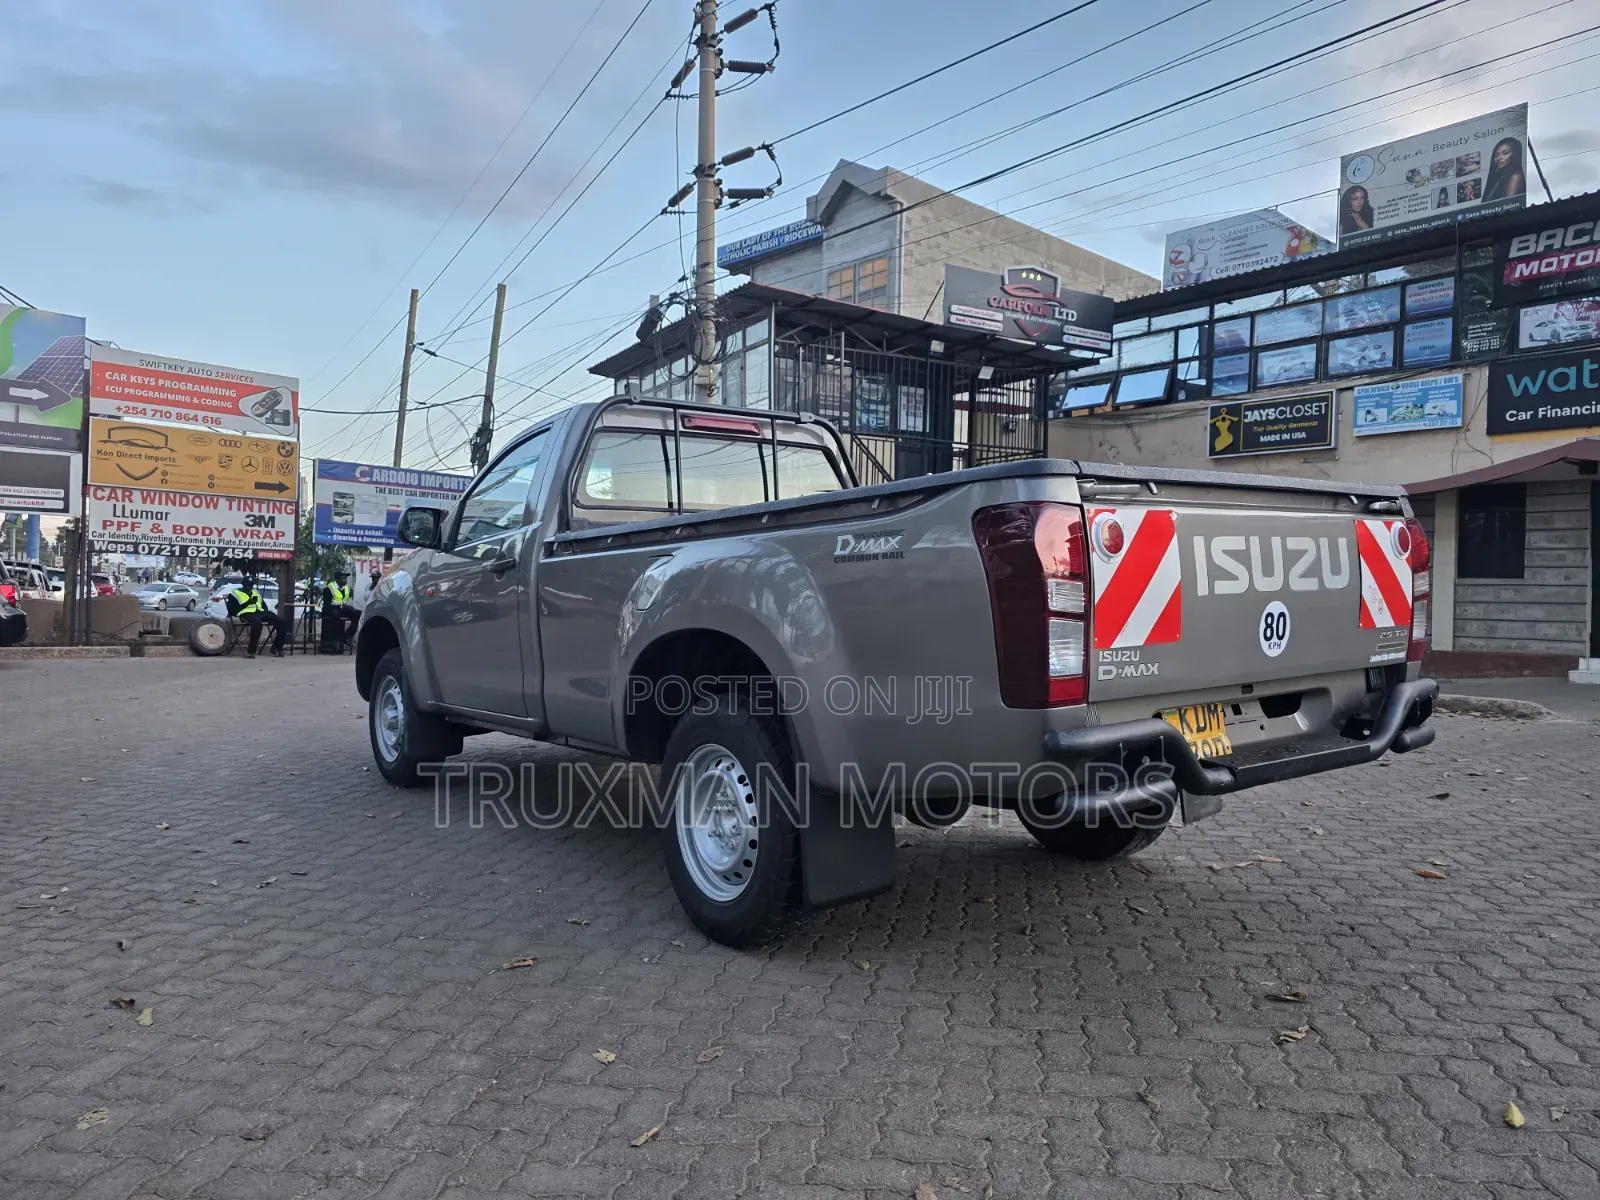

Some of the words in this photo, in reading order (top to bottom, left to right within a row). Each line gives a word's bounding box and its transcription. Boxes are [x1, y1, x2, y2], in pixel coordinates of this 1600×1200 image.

[1377, 146, 1428, 175] Sana
[1431, 136, 1470, 153] Beauty
[1473, 126, 1504, 141] Salon
[1481, 206, 1501, 215] Beauty
[1502, 202, 1520, 210] Salon
[1219, 226, 1254, 239] CLEANING
[1508, 220, 1600, 258] BAC
[726, 242, 741, 252] OUR
[741, 235, 761, 247] LADY
[762, 231, 773, 240] OF
[718, 247, 751, 263] CATHOLIC
[752, 239, 779, 253] PARISH
[1215, 262, 1231, 274] Cell:
[1232, 255, 1278, 272] 0710392472
[1417, 281, 1444, 291] SERVICES
[1539, 281, 1563, 290] DIRECT
[1565, 276, 1595, 286] IMPORTS
[1408, 290, 1428, 298] DIRECT
[1428, 286, 1454, 295] IMPORTS
[1411, 295, 1434, 304] LOCALLY
[1005, 310, 1025, 320] Quality
[1054, 306, 1077, 321] LTD
[1411, 322, 1435, 330] CONTACT
[139, 359, 185, 372] SWIFTKEY
[187, 366, 213, 377] AUTO
[215, 371, 254, 383] SERVICES
[105, 371, 127, 382] CAR
[130, 374, 156, 386] KEYS
[158, 378, 237, 398] PROGRAMMING
[1357, 387, 1370, 395] SPIN
[1370, 385, 1391, 394] AFRICA
[1400, 381, 1420, 390] HOUSE
[1420, 378, 1439, 387] HELPS
[105, 385, 122, 393] ECU
[124, 387, 191, 403] PROGRAMMING
[201, 398, 233, 409] CODING
[115, 405, 147, 416] +254
[150, 409, 172, 419] 710
[175, 412, 199, 423] 864
[202, 415, 222, 425] 616
[1243, 402, 1328, 423] JAYSCLOSET
[1505, 410, 1534, 421] Car
[1265, 423, 1287, 432] Quality
[1288, 421, 1318, 429] Garments
[1260, 434, 1280, 442] MADE
[1292, 431, 1306, 439] USA
[116, 450, 143, 460] Direct
[144, 453, 176, 463] Imports
[355, 465, 419, 487] CARDOJO
[421, 473, 473, 491] IMPORTS
[92, 486, 134, 503] CAR
[140, 490, 220, 510] WINDOW
[225, 497, 295, 515] TINTING
[375, 486, 387, 494] THE
[388, 488, 403, 496] BEST
[404, 489, 418, 497] CAR
[418, 490, 450, 500] IMPORTER
[112, 503, 171, 521] LLumar
[243, 513, 276, 529] 3M
[91, 530, 106, 539] Car
[206, 537, 216, 545] No
[102, 520, 142, 532] PPF
[149, 523, 164, 534] &
[172, 524, 227, 538] BODY
[233, 528, 286, 540] WRAP
[333, 526, 356, 535] Imports
[332, 534, 358, 542] Clearing
[93, 540, 134, 554] Weps
[138, 543, 180, 556] 0721
[187, 546, 219, 558] 620
[223, 548, 254, 559] 454
[834, 552, 879, 564] COMMON
[881, 551, 905, 560] RAIL
[1192, 535, 1350, 597] ISUZU
[1263, 611, 1287, 642] 80
[1267, 641, 1282, 650] KPH
[1098, 650, 1140, 663] ISUZU
